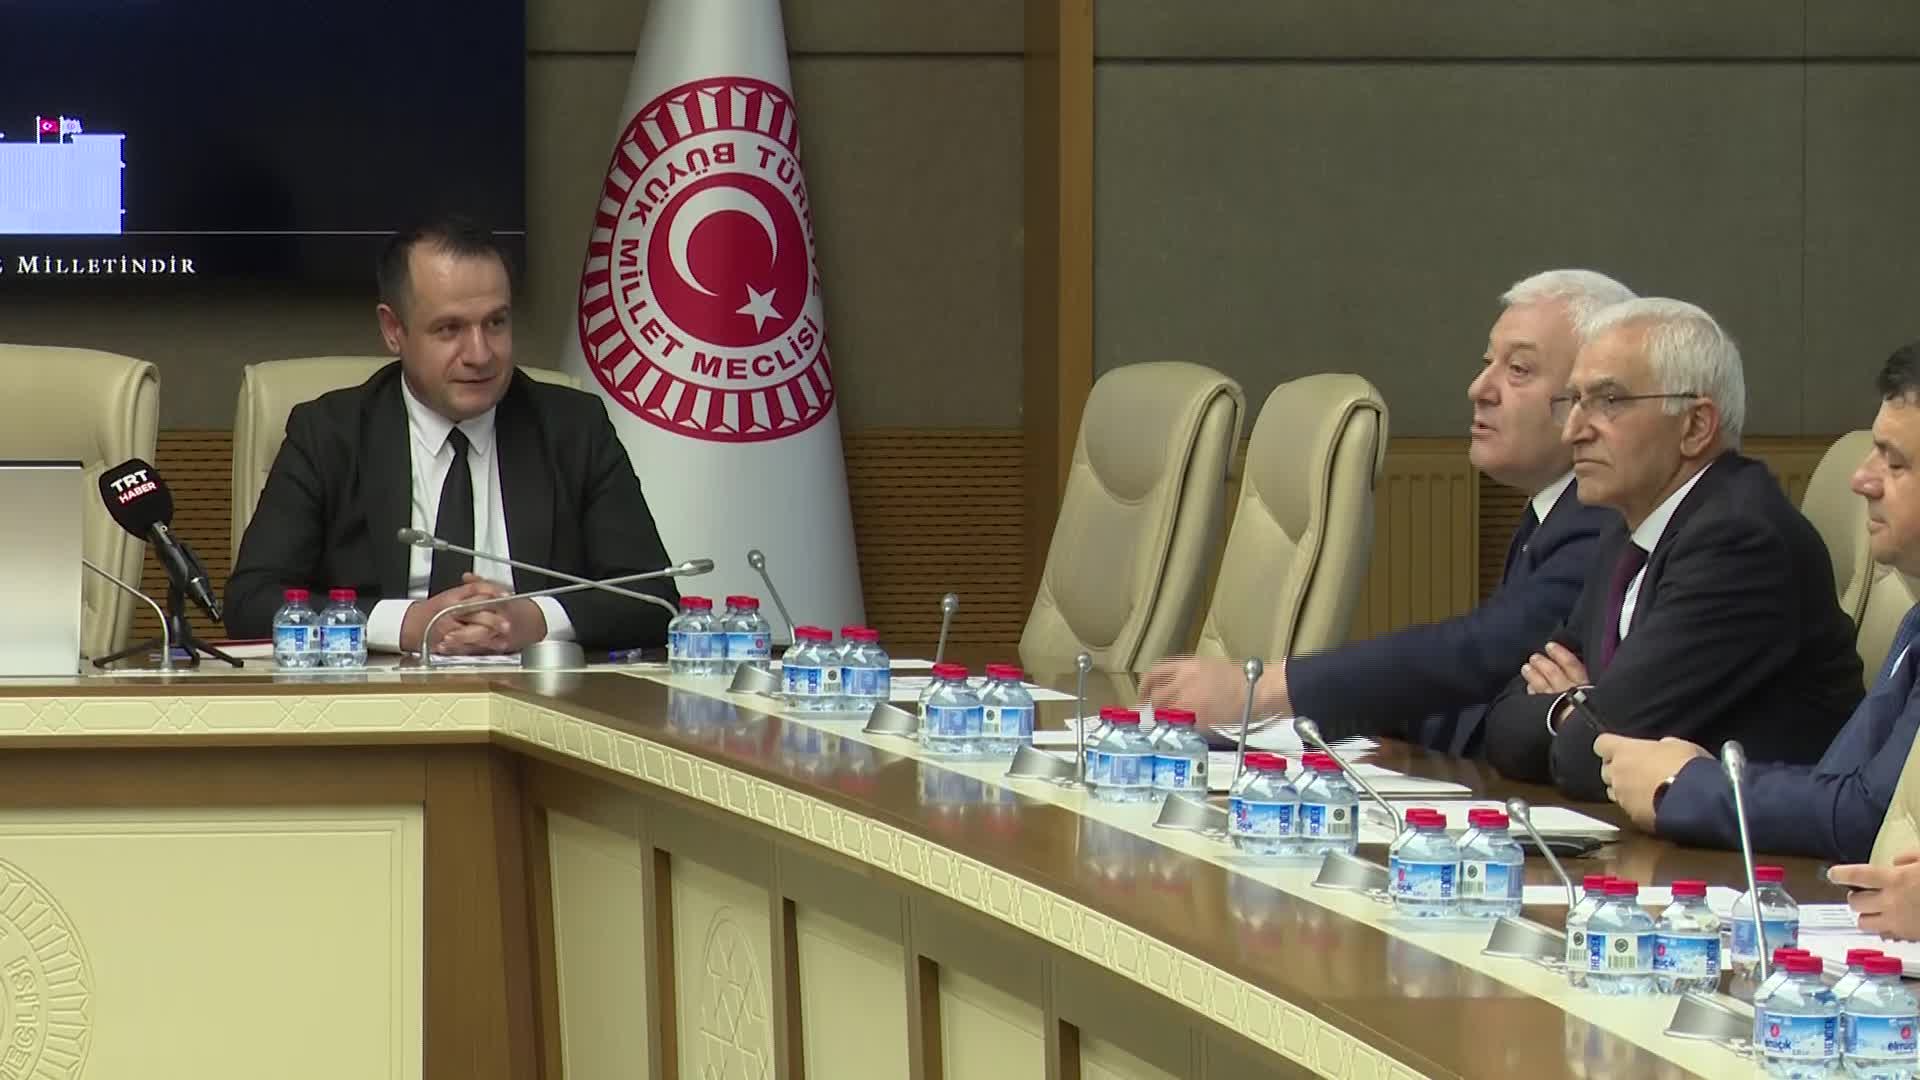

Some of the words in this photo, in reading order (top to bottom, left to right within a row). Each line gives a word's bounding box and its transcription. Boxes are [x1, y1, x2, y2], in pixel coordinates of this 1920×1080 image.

[628, 142, 735, 227] BÜYÜK
[17, 255, 197, 275] MİLLETİNDİR
[618, 238, 685, 358] MİLLET
[690, 315, 819, 380] MECLİSİ
[110, 468, 149, 494] TRT
[118, 481, 157, 505] HABER
